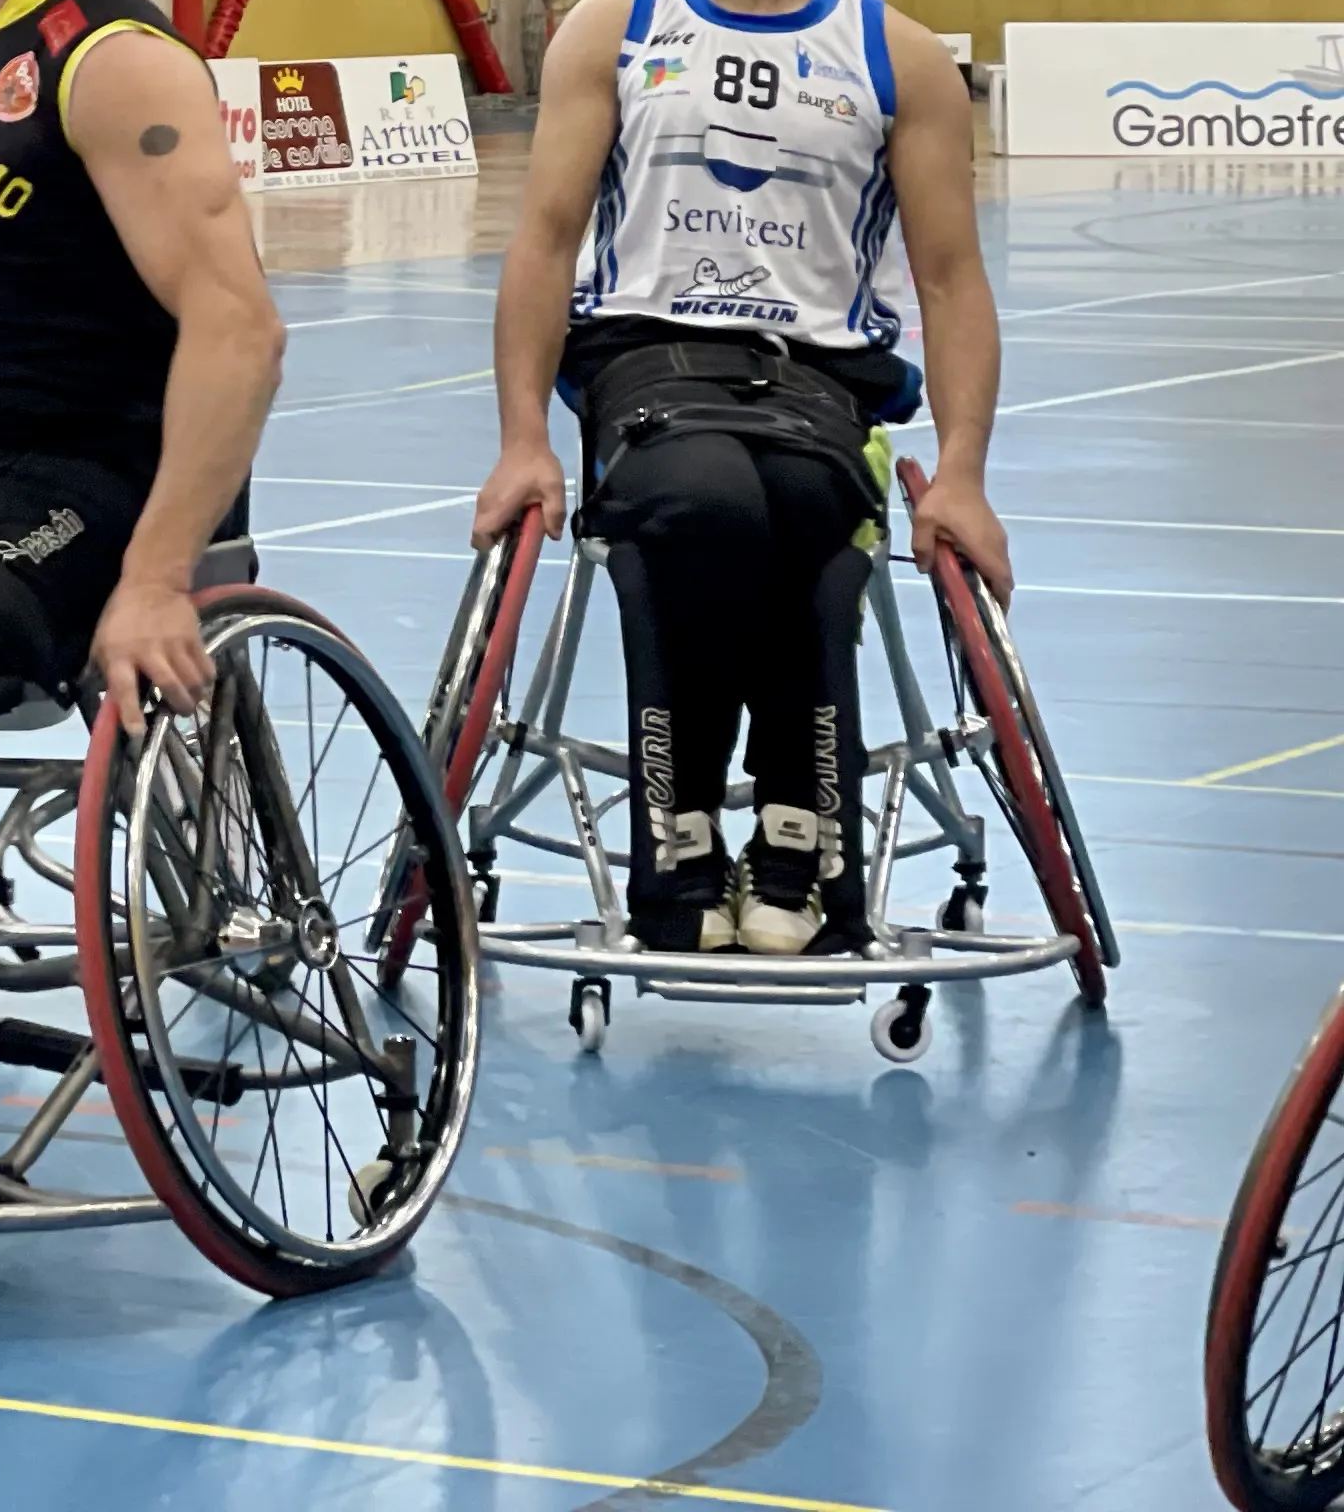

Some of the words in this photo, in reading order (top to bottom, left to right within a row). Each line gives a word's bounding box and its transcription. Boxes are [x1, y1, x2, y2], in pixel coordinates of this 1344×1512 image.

[713, 53, 781, 111] 89
[276, 96, 313, 113] HOTEL
[262, 115, 336, 140] corona
[362, 149, 473, 167] HOTEL
[663, 198, 808, 251] Servigest
[669, 299, 799, 324] MICHELIN
